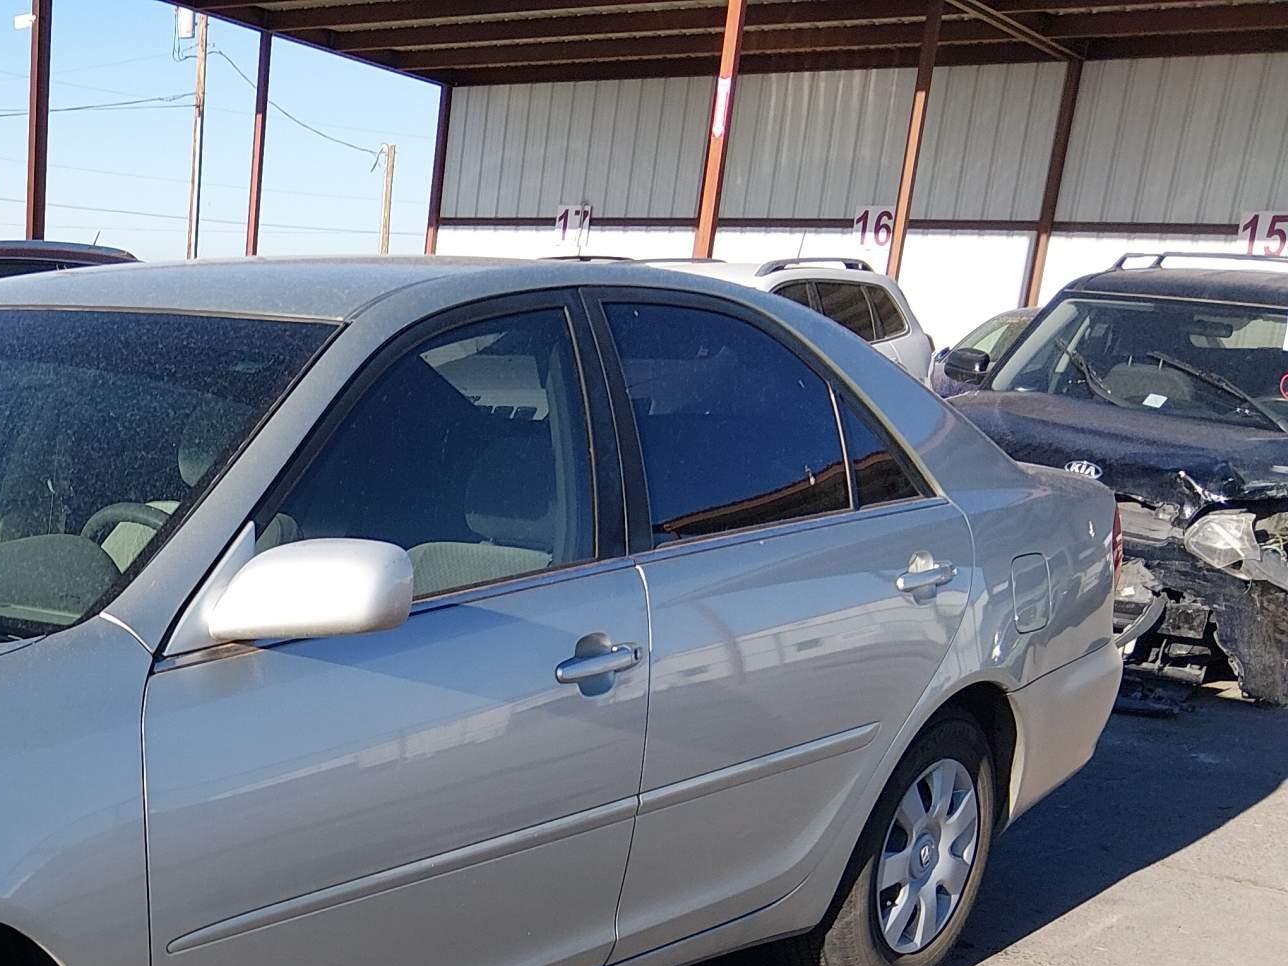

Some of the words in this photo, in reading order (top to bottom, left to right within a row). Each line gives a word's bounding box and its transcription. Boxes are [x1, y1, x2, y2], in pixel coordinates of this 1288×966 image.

[855, 209, 893, 246] 16
[1242, 214, 1288, 256] 15
[1069, 461, 1098, 477] KIA
